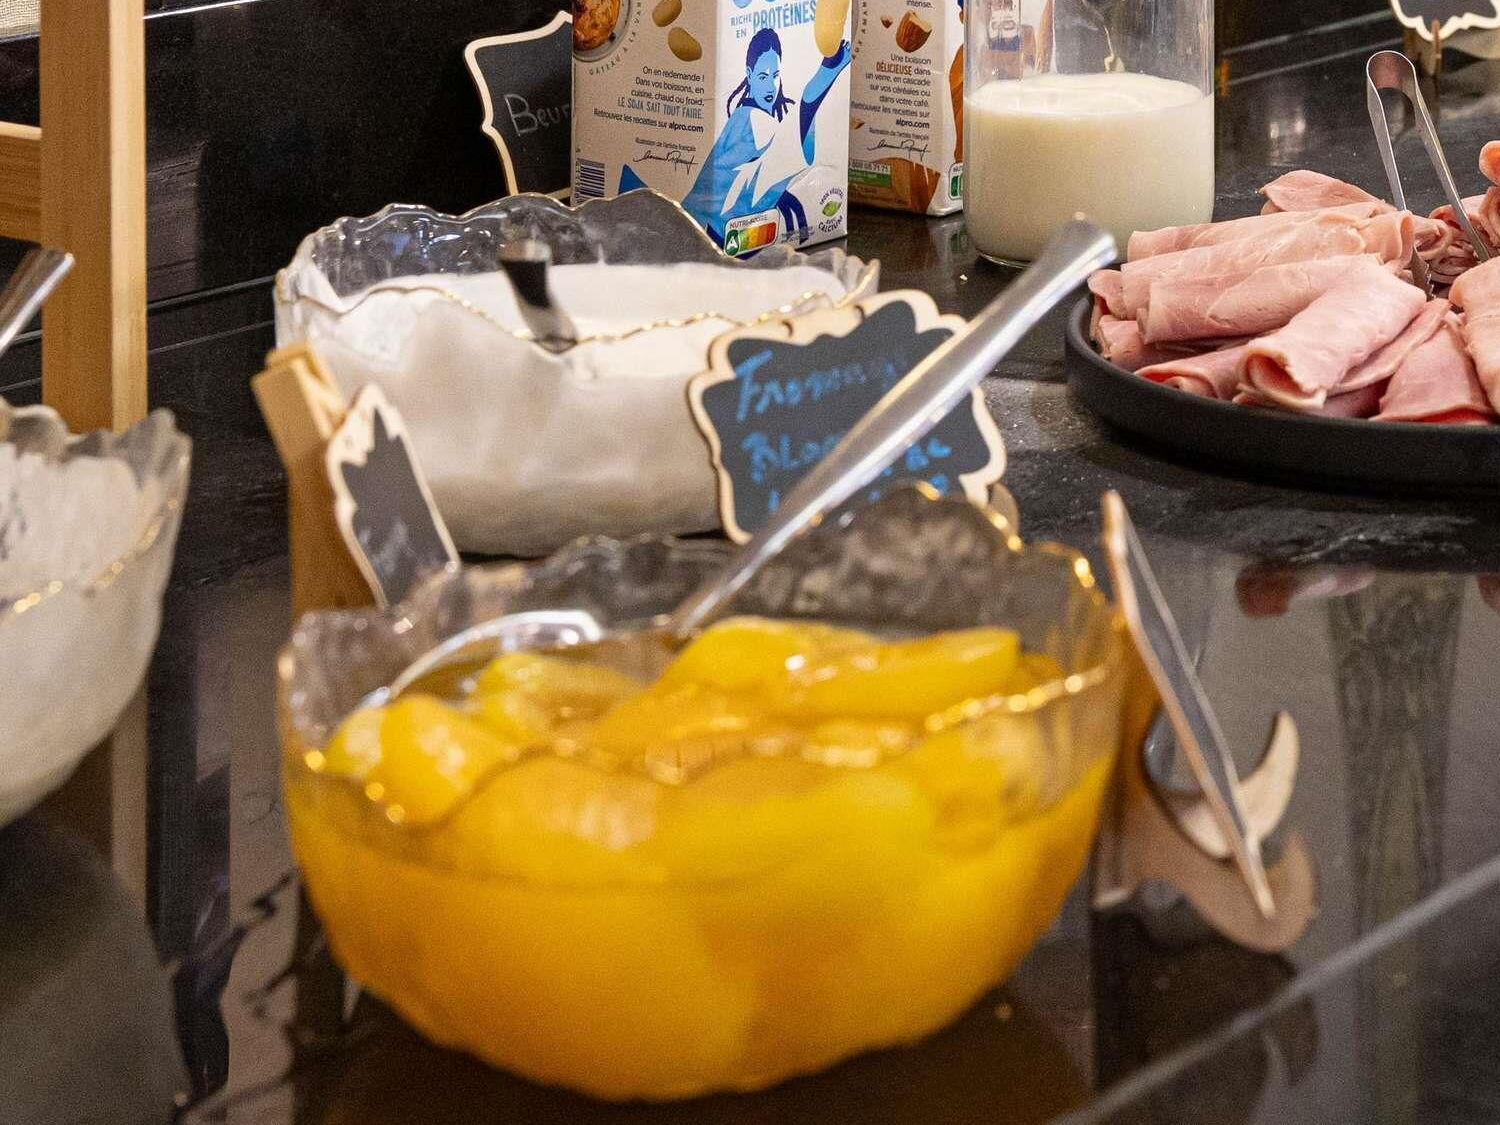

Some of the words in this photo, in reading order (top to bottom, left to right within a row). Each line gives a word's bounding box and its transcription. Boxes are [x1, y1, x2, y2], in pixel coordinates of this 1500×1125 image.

[752, 0, 817, 34] PROTÉINES
[736, 26, 747, 39] EN
[643, 65, 652, 75] On
[654, 69, 661, 77] en
[914, 66, 931, 76] dans
[635, 76, 650, 86] Dans
[651, 80, 662, 88] vos
[655, 92, 674, 103] chaud
[618, 97, 625, 107] LE
[628, 98, 644, 110] SOJA
[646, 101, 661, 113] SAIT
[663, 104, 680, 116] TOUT
[668, 120, 704, 132] alpro.com
[896, 117, 930, 129] alpro.com
